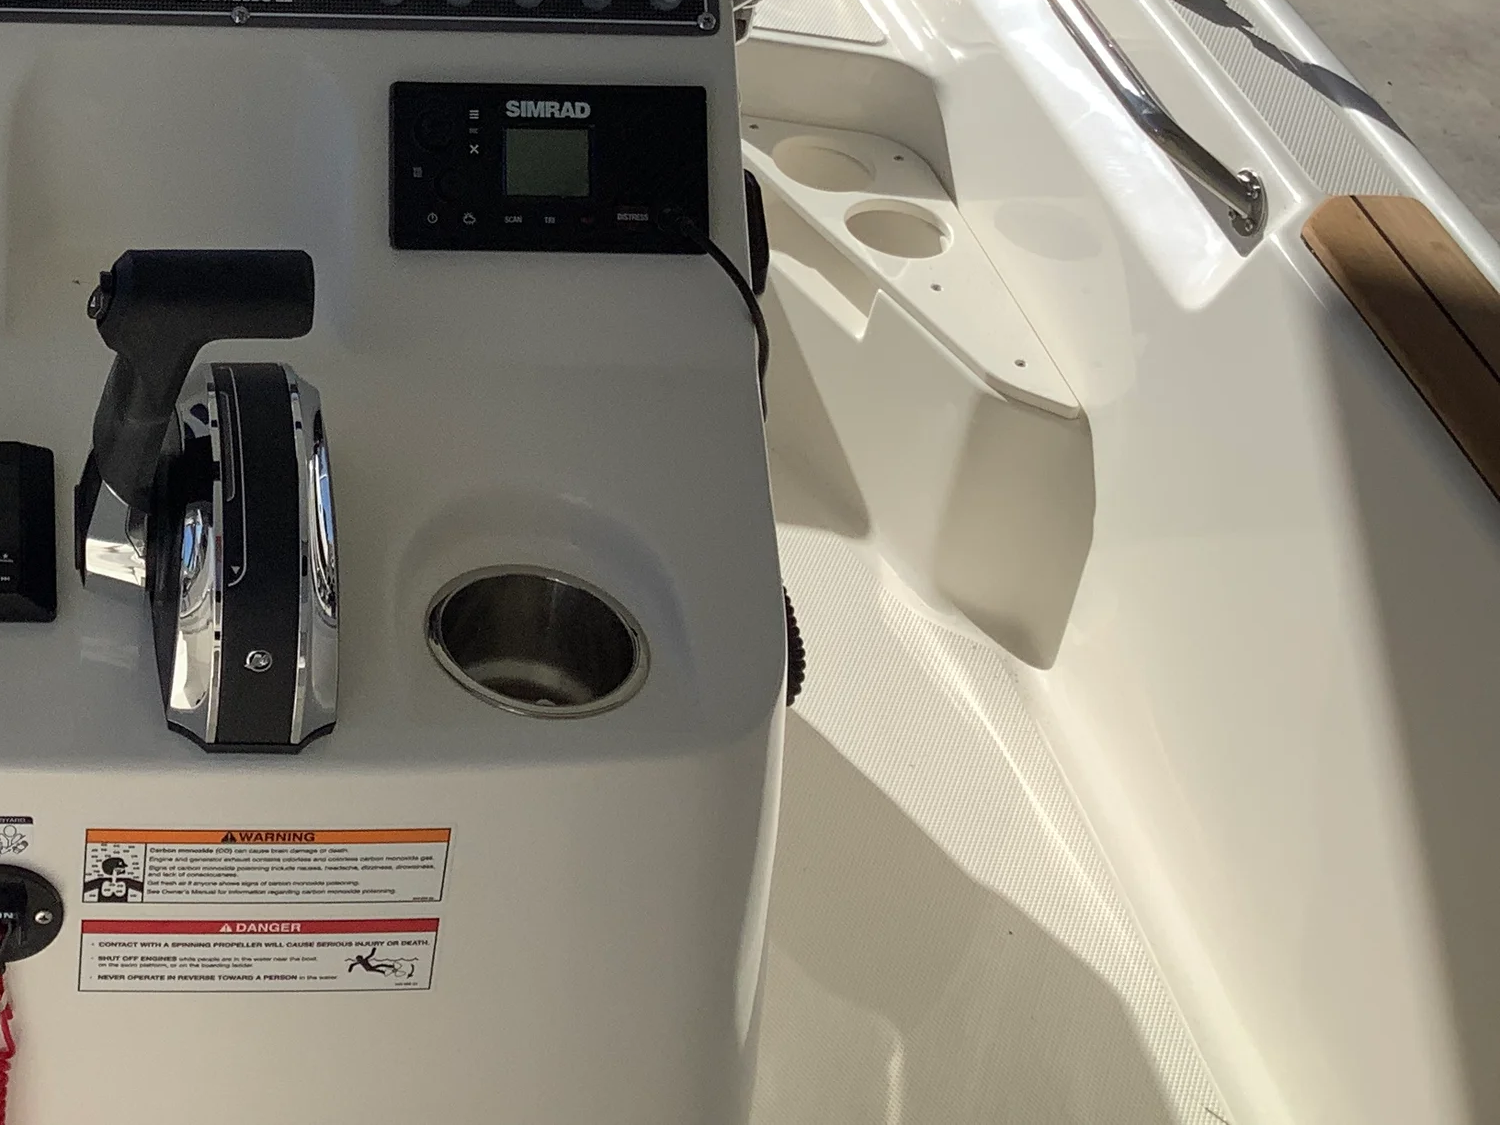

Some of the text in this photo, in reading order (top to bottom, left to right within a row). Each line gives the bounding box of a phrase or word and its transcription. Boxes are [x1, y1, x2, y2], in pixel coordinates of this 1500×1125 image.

[505, 100, 591, 119] SIMRAD
[239, 832, 315, 842] WARNING
[236, 923, 301, 932] DANGER
